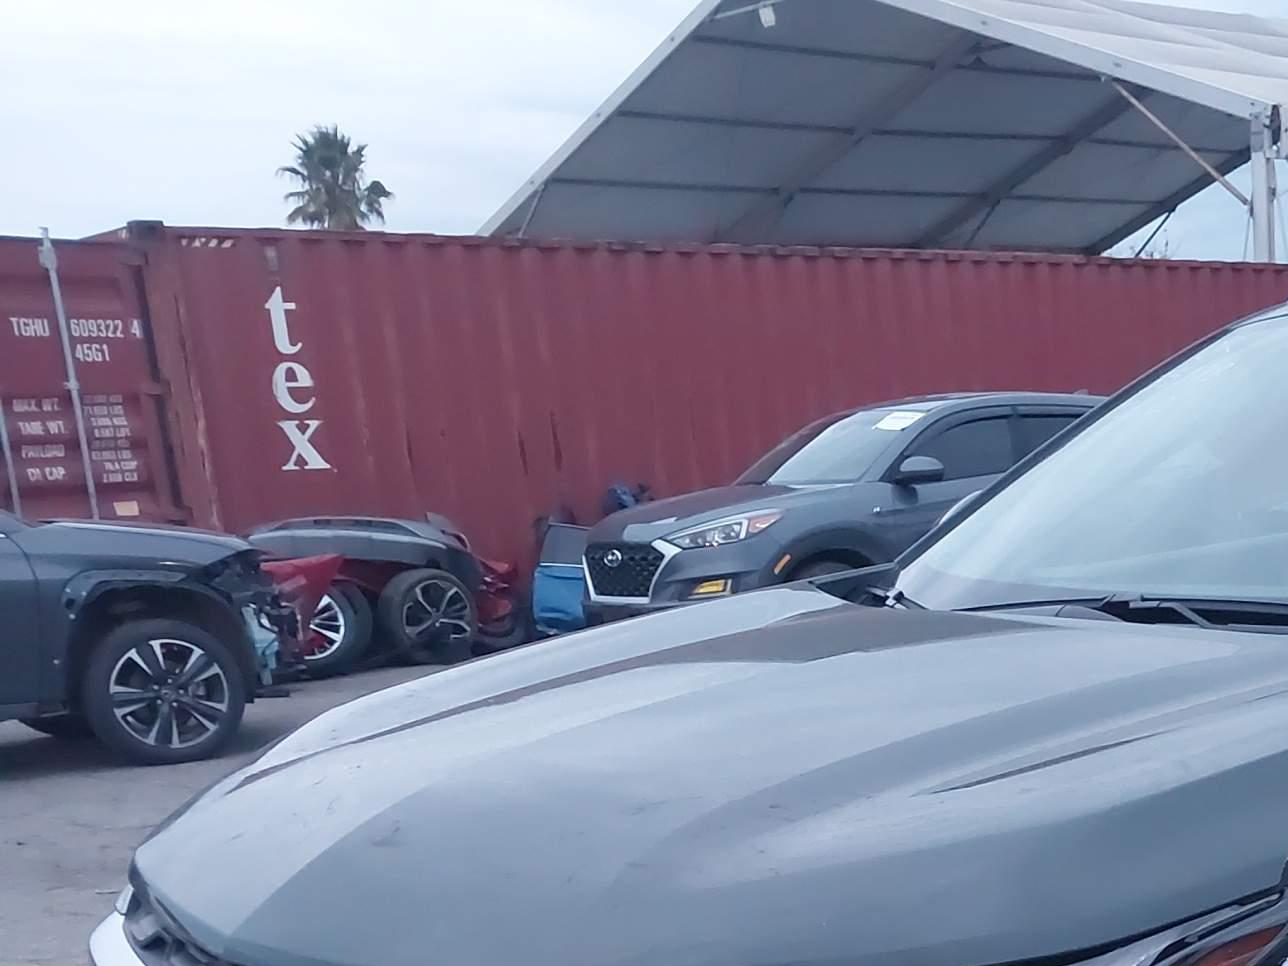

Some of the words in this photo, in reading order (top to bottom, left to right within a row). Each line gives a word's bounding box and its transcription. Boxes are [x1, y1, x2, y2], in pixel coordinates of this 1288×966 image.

[9, 317, 50, 337] TGHU
[70, 319, 125, 338] 609322
[131, 318, 142, 338] 4
[74, 343, 110, 362] 45G1
[264, 285, 333, 472] tex
